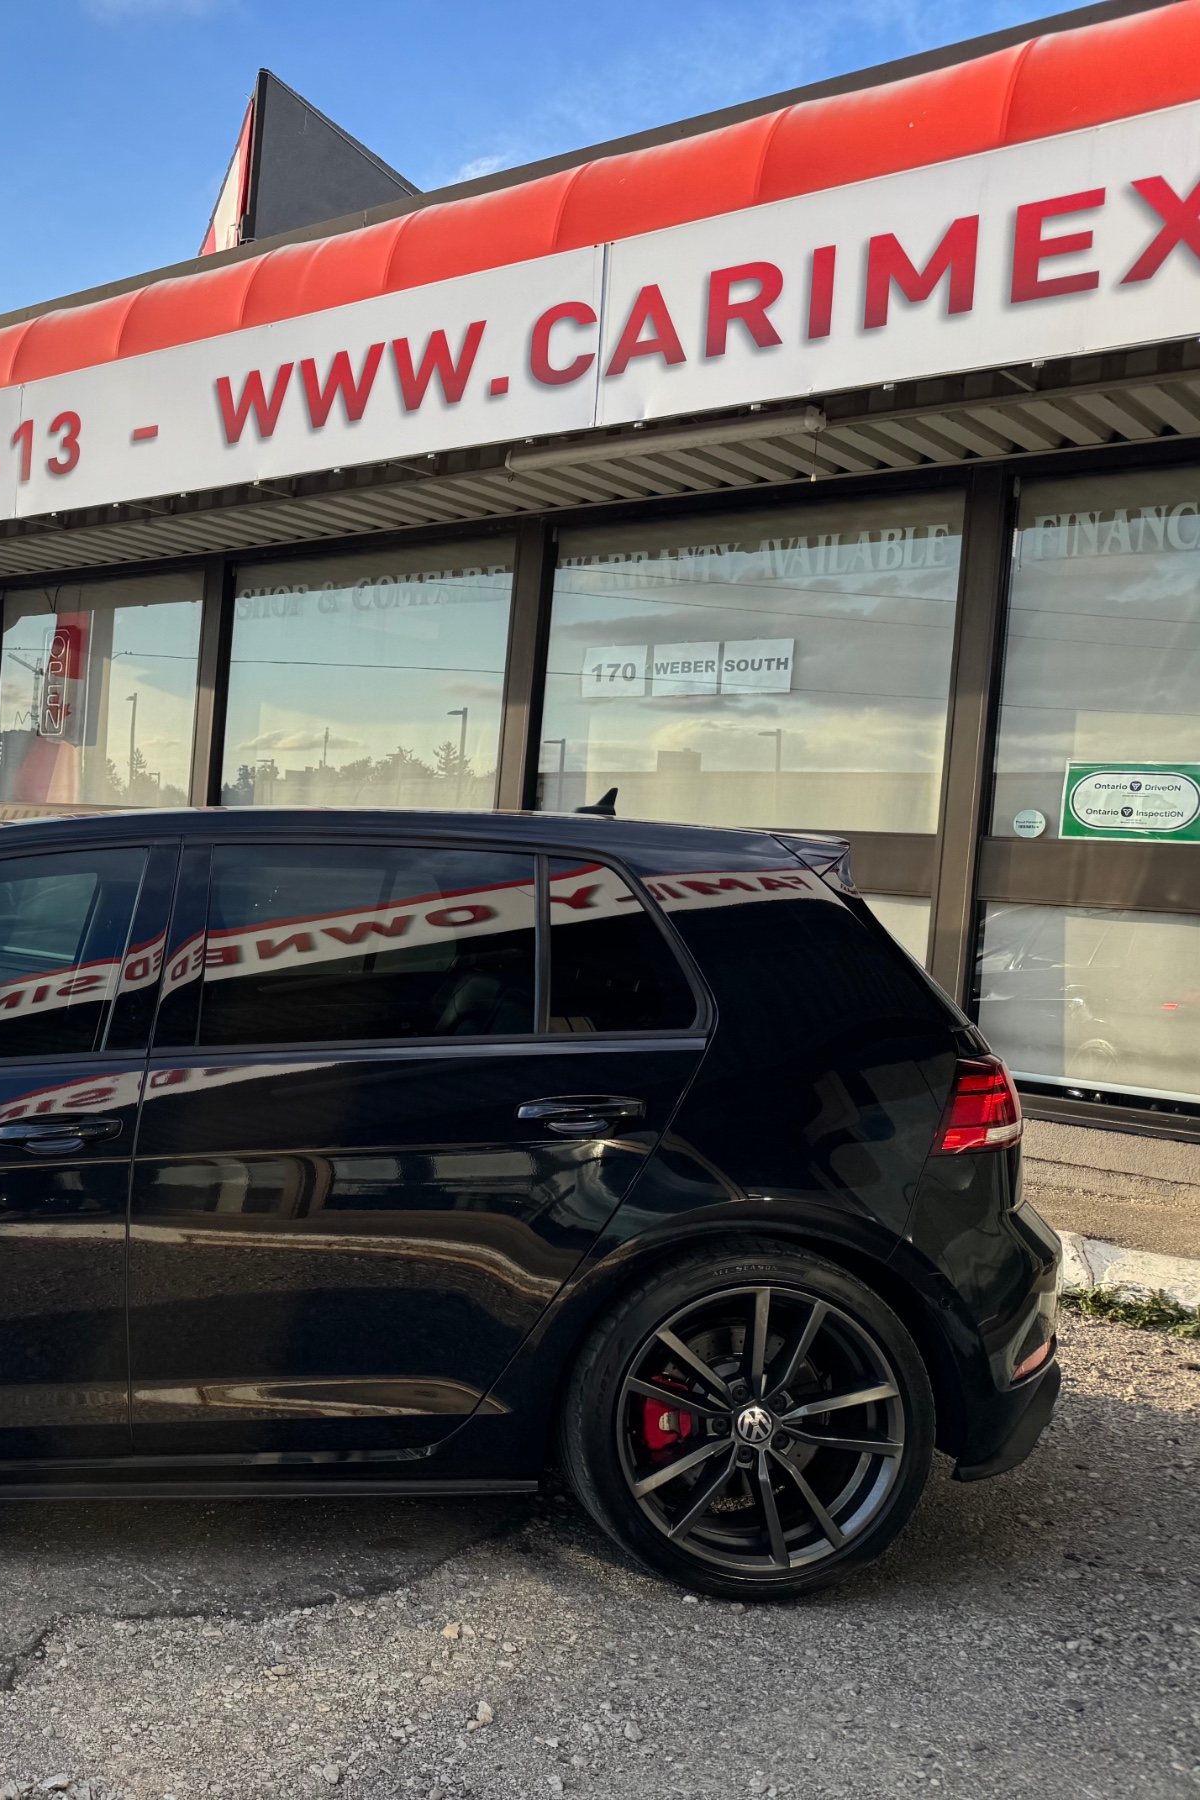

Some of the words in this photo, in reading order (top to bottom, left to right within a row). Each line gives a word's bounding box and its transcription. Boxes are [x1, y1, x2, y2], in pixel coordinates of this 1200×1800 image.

[757, 524, 950, 579] AVAILABLE
[236, 583, 310, 620] SHOP
[45, 635, 66, 729] OPEN
[591, 662, 637, 682] 170
[654, 660, 716, 675] WEBER
[724, 657, 789, 673] SOUTH
[1094, 782, 1128, 790] Ontario
[1144, 784, 1182, 792] DriveON
[1086, 808, 1119, 816] Ontario
[1136, 809, 1184, 818] InspectiON
